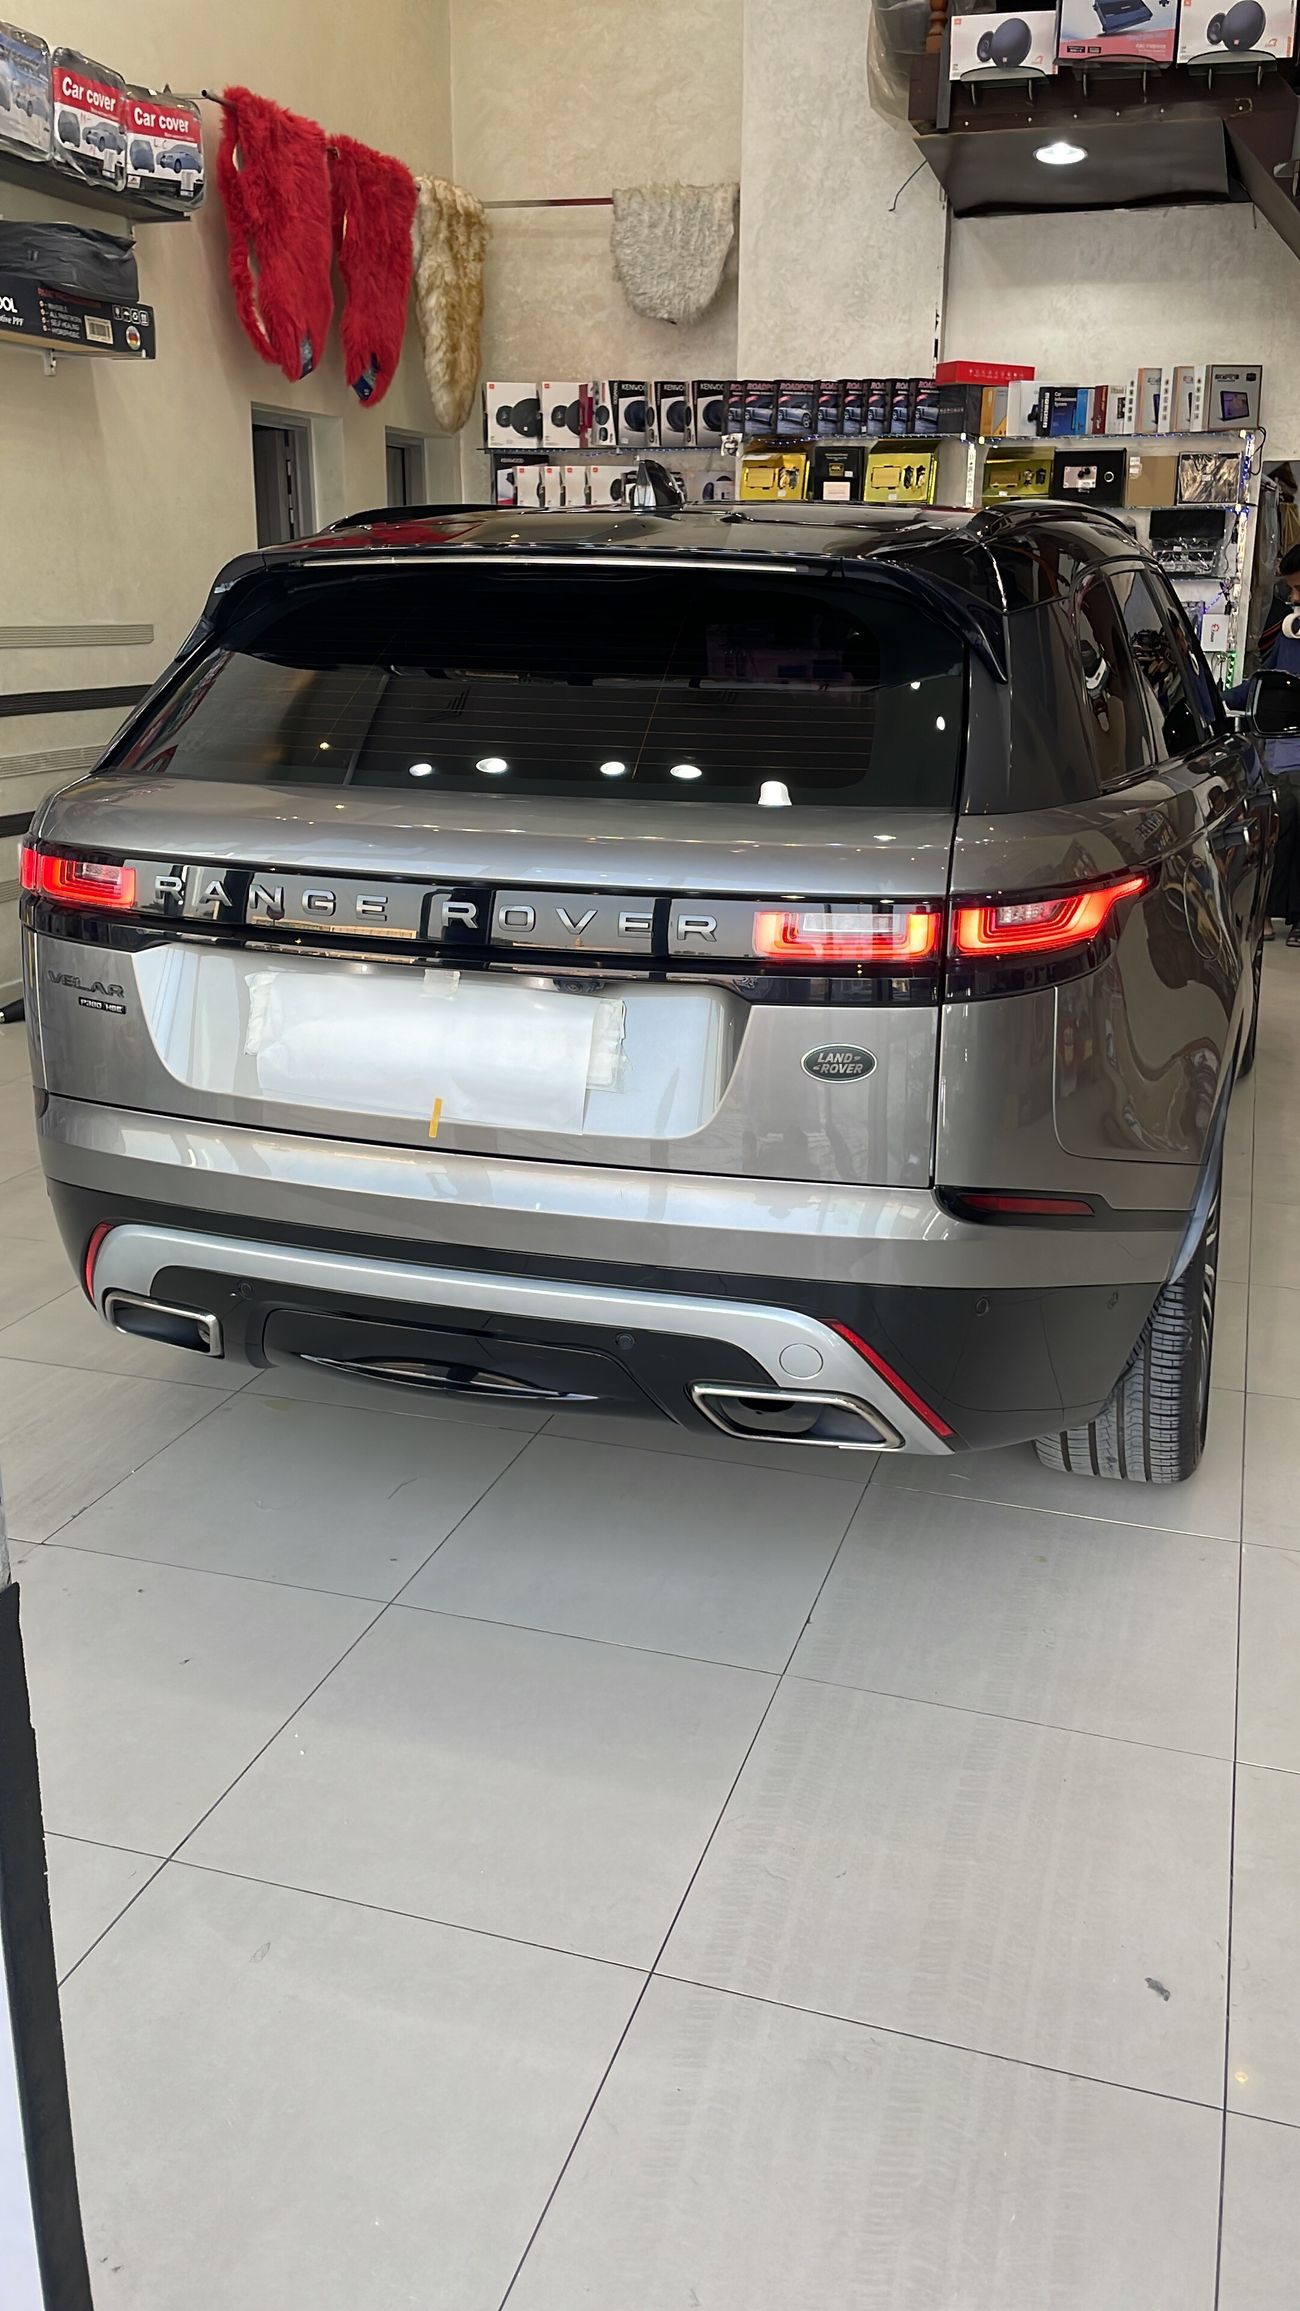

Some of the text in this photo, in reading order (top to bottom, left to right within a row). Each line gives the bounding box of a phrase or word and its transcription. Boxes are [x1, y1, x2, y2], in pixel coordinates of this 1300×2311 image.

[62, 76, 116, 112] Car cover
[134, 107, 156, 127] Car
[159, 115, 189, 133] cover
[155, 876, 717, 942] RANGE ROVER
[48, 970, 125, 998] VELAR
[818, 1053, 853, 1063] LAND
[821, 1063, 863, 1074] ROVER
